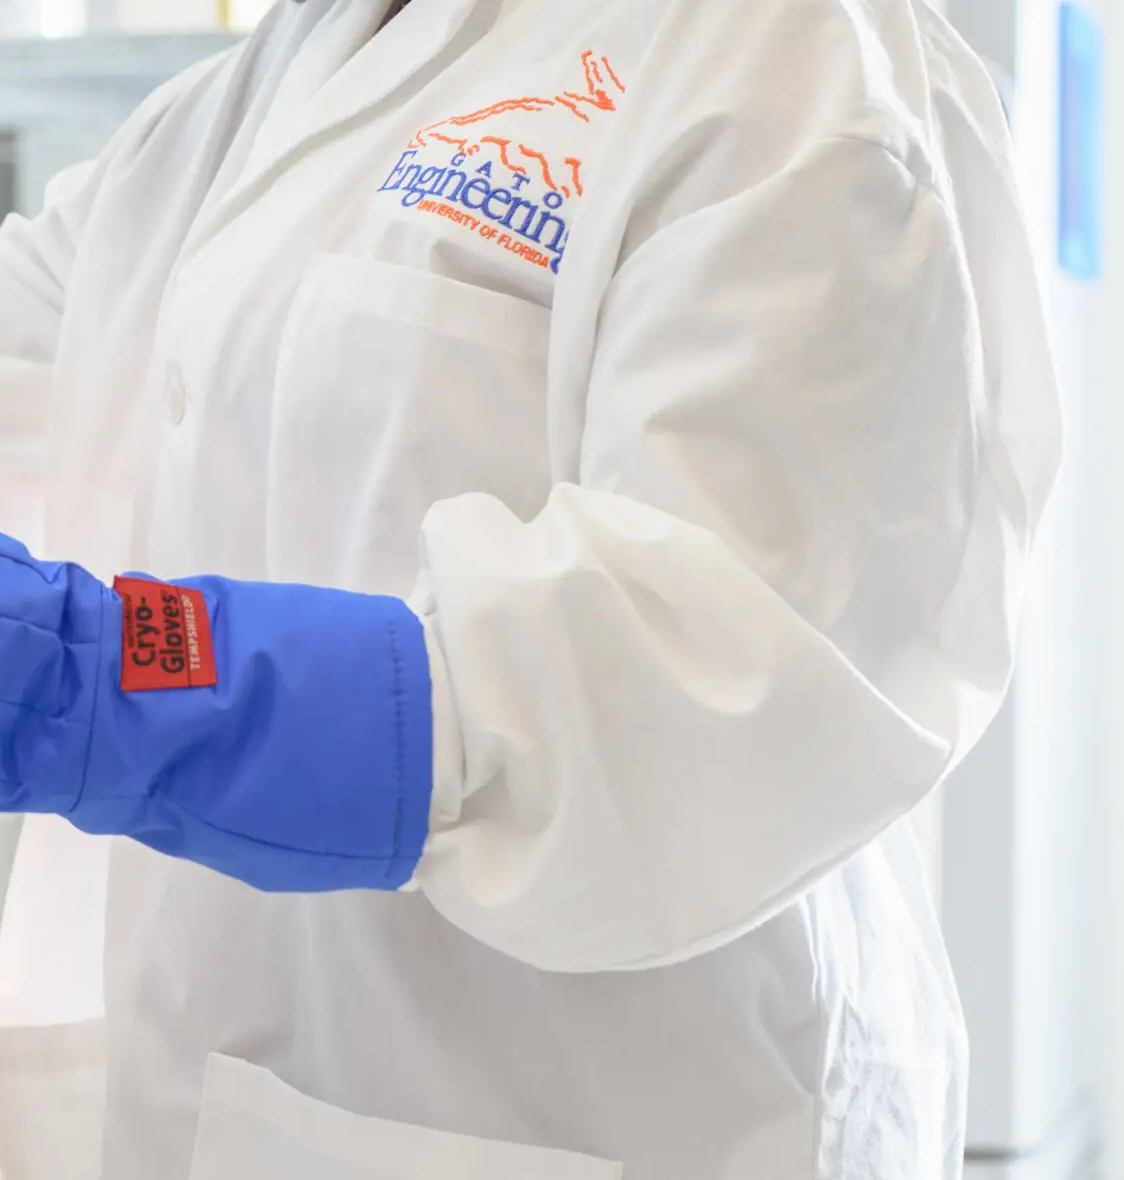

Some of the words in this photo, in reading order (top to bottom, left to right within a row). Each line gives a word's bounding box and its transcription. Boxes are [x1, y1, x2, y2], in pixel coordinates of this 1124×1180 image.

[417, 199, 481, 232] UNIVERSITY
[478, 224, 499, 241] OF
[497, 233, 550, 269] FLORIDA
[132, 596, 160, 666] Cryo-
[159, 593, 185, 673] Gloves
